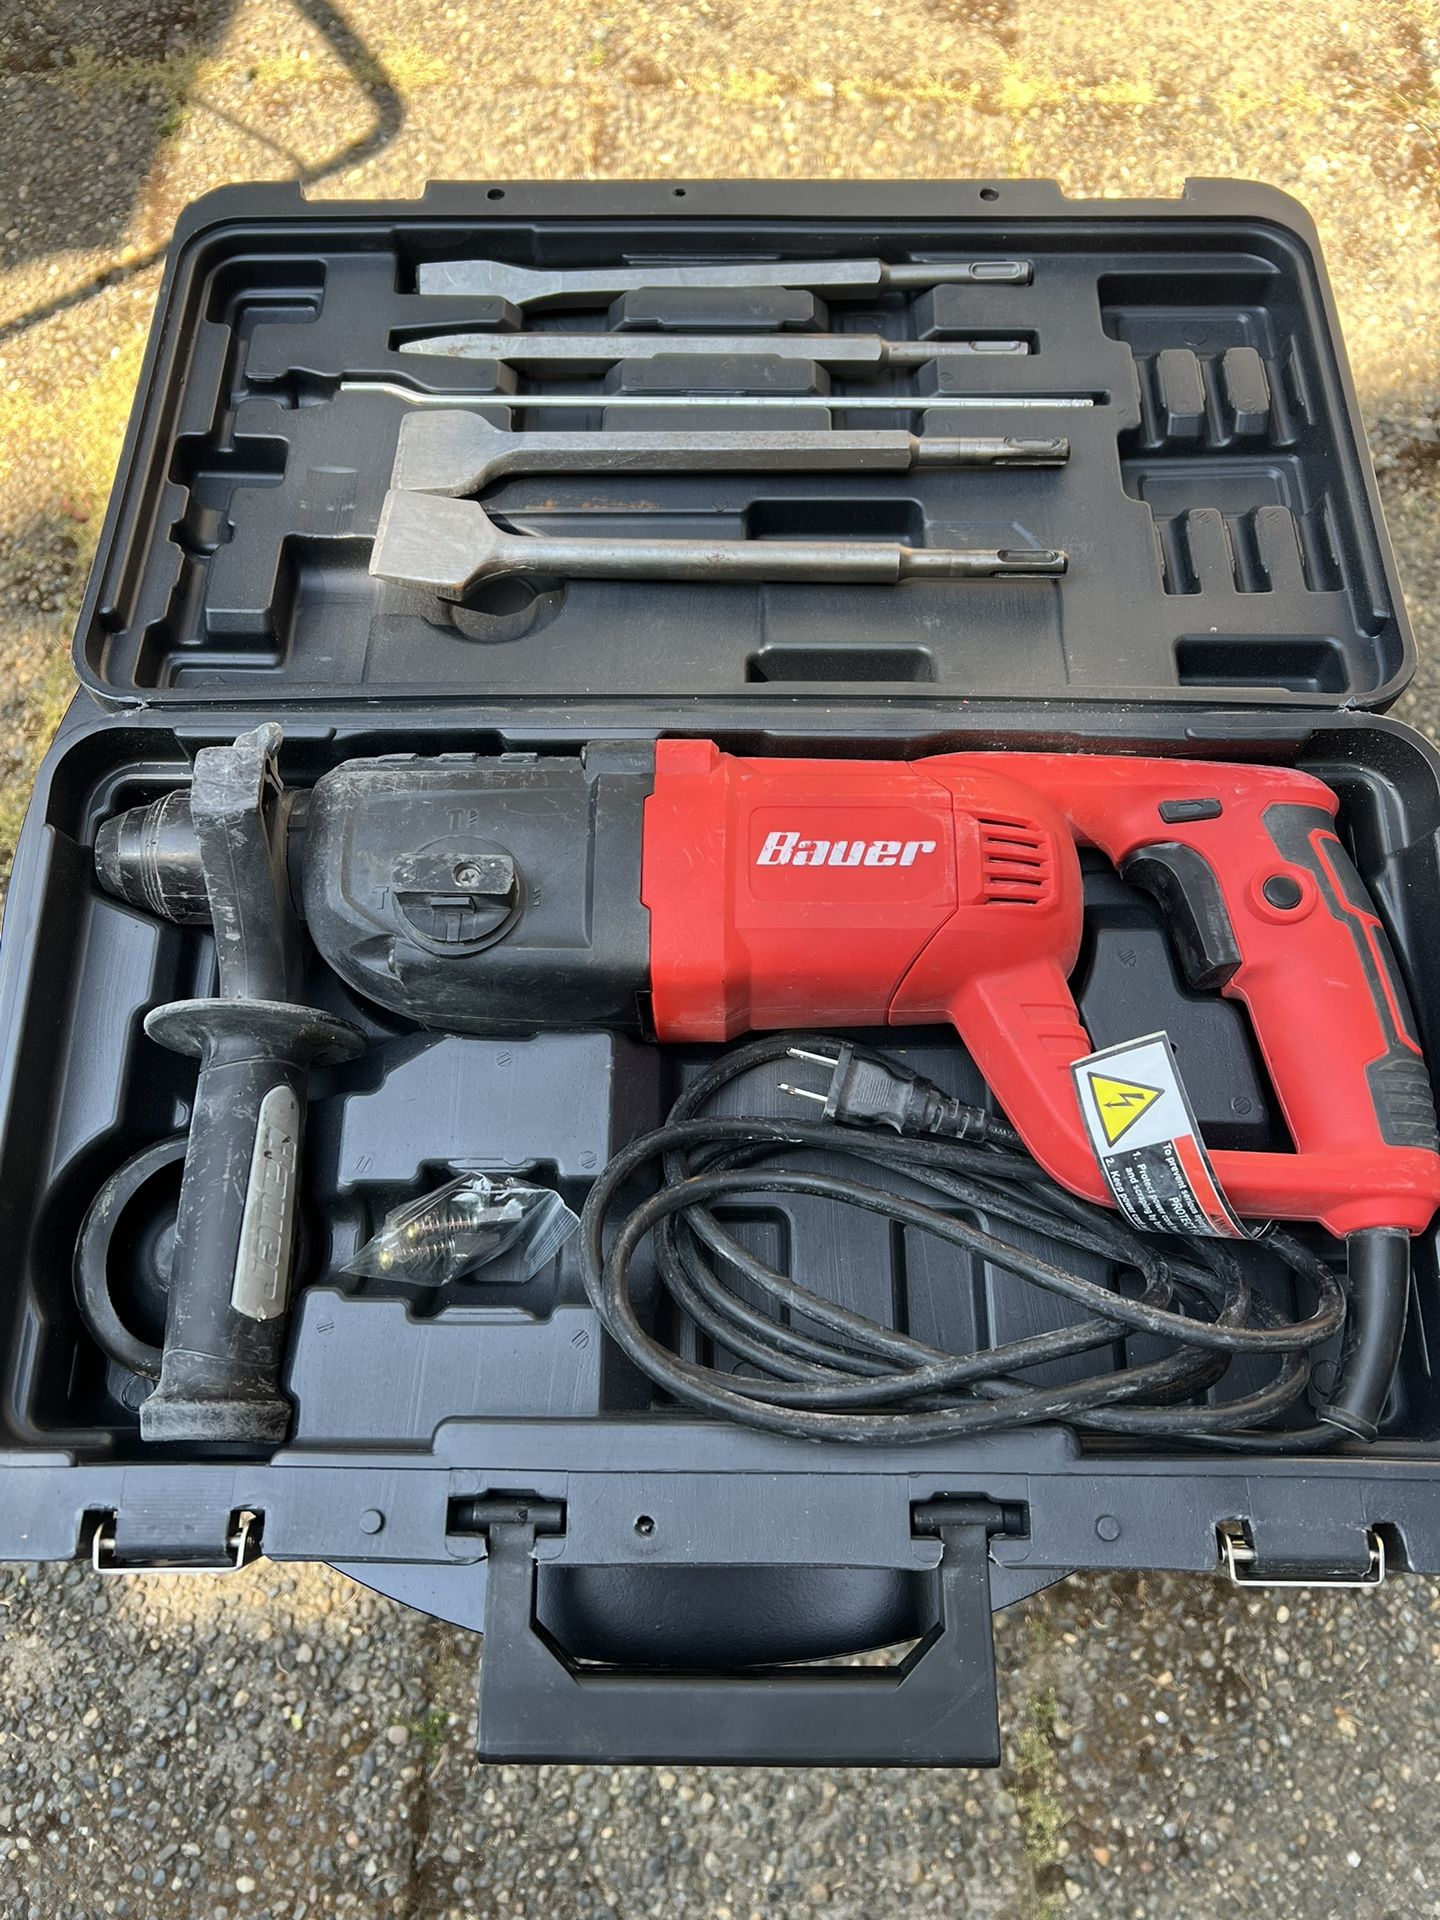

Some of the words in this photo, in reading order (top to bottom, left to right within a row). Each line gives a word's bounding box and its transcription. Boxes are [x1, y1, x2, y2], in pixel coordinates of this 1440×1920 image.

[756, 832, 937, 866] Bauer
[1162, 1143, 1173, 1156] To
[1132, 1150, 1142, 1160] 1.
[1137, 1163, 1156, 1194] Protect
[1148, 1194, 1166, 1214] power
[1162, 1215, 1175, 1226] cord
[1165, 1157, 1187, 1189] prevent
[1105, 1157, 1115, 1167] 2.
[1110, 1170, 1125, 1193] Keep
[1119, 1193, 1136, 1213] power
[1132, 1214, 1146, 1225] cord
[1125, 1166, 1139, 1184] and
[1133, 1185, 1152, 1214] scraping
[1181, 1190, 1199, 1214] serious
[1168, 1197, 1197, 1230] PROTECT
